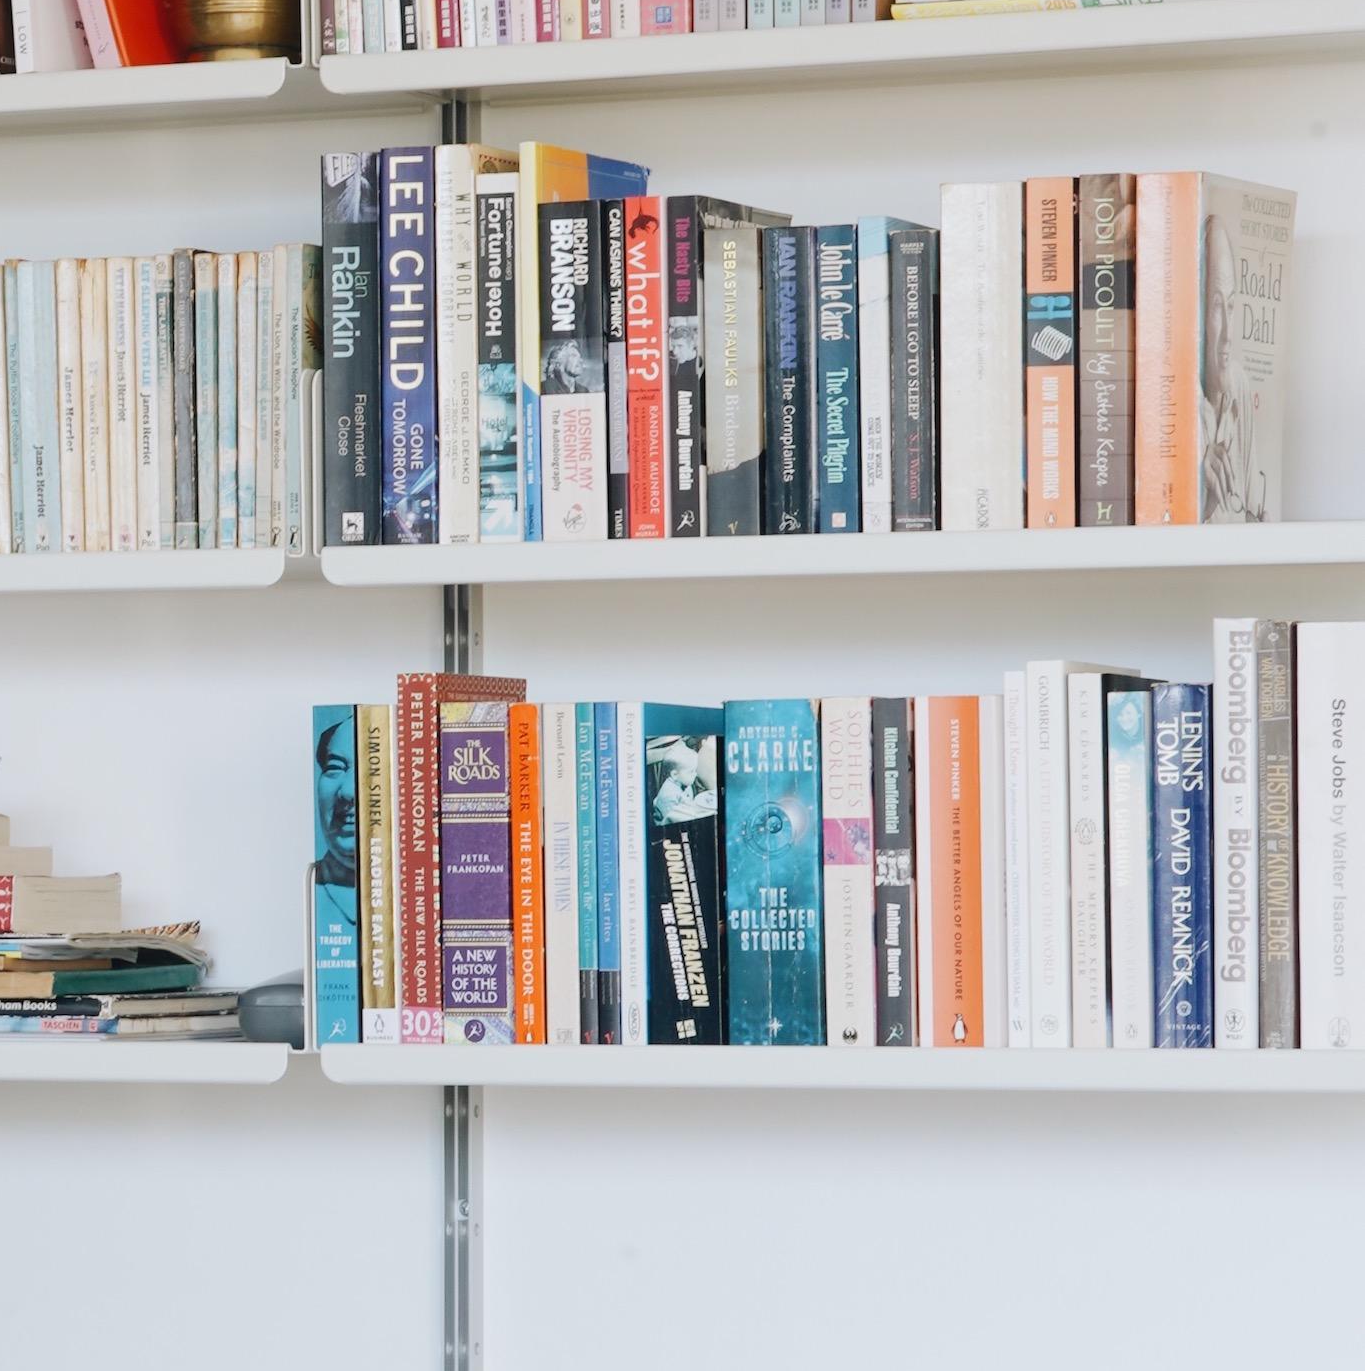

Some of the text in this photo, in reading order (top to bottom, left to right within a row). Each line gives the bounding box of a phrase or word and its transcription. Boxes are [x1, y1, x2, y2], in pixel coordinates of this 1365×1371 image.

[356, 271, 371, 298] Ian
[389, 155, 425, 390] LEE CHILD
[485, 198, 504, 335] Fortune Hotel
[551, 219, 574, 330] BRANSON
[573, 219, 587, 285] RICHARD
[610, 209, 622, 337] CAN ASIANS THINK?
[817, 243, 850, 340] John le Carré
[1092, 197, 1115, 349] JODI PICOULT
[332, 246, 360, 358] Rankin
[627, 241, 660, 380] what if?
[290, 308, 299, 399] The Magician's Nephew
[338, 416, 350, 456] Close
[354, 395, 367, 477] Fleshmarket
[393, 399, 406, 494] TOMORROW
[410, 424, 424, 470] GONE
[563, 410, 577, 481] VIRGINITY
[577, 409, 592, 490] LOSING MY
[648, 405, 659, 514] RANDALL MUNROE
[676, 391, 694, 490] Anthony Bourdain
[822, 368, 849, 483] The Secret Pilgrim
[1091, 353, 1116, 486] My Sister's Keeper
[448, 766, 500, 784] ROADS
[453, 748, 491, 764] SILK
[727, 741, 818, 774] CLARKE
[884, 728, 899, 834] Kitchen Confidential
[1157, 718, 1178, 785] TOMB
[1181, 711, 1203, 791] LENIN'S
[411, 692, 427, 1003] PETER FRANKOPAN THE NEW SILK ROADS
[1221, 630, 1253, 982] Bloomberg BY Bloomberg
[1330, 699, 1348, 977] Steve Jobs by Walter Isaacson
[368, 727, 384, 987] SIMON SINEK LEADERS EAT LAST
[517, 722, 534, 996] PAT BARKER THE EYE IN THE DOOR
[760, 889, 788, 906] THE
[950, 719, 963, 1001] STEVEN PINKER THE BETTER ANGELS OF OUR NATURE
[1169, 809, 1192, 984] DAVID REMNICK
[661, 903, 689, 1000] THE CORRECTIONS
[663, 840, 709, 1006] JONATHAN FRANZEN
[729, 909, 816, 929] COLLECTED
[741, 930, 805, 950] STORIES
[885, 903, 902, 997] Anthony Bourdain
